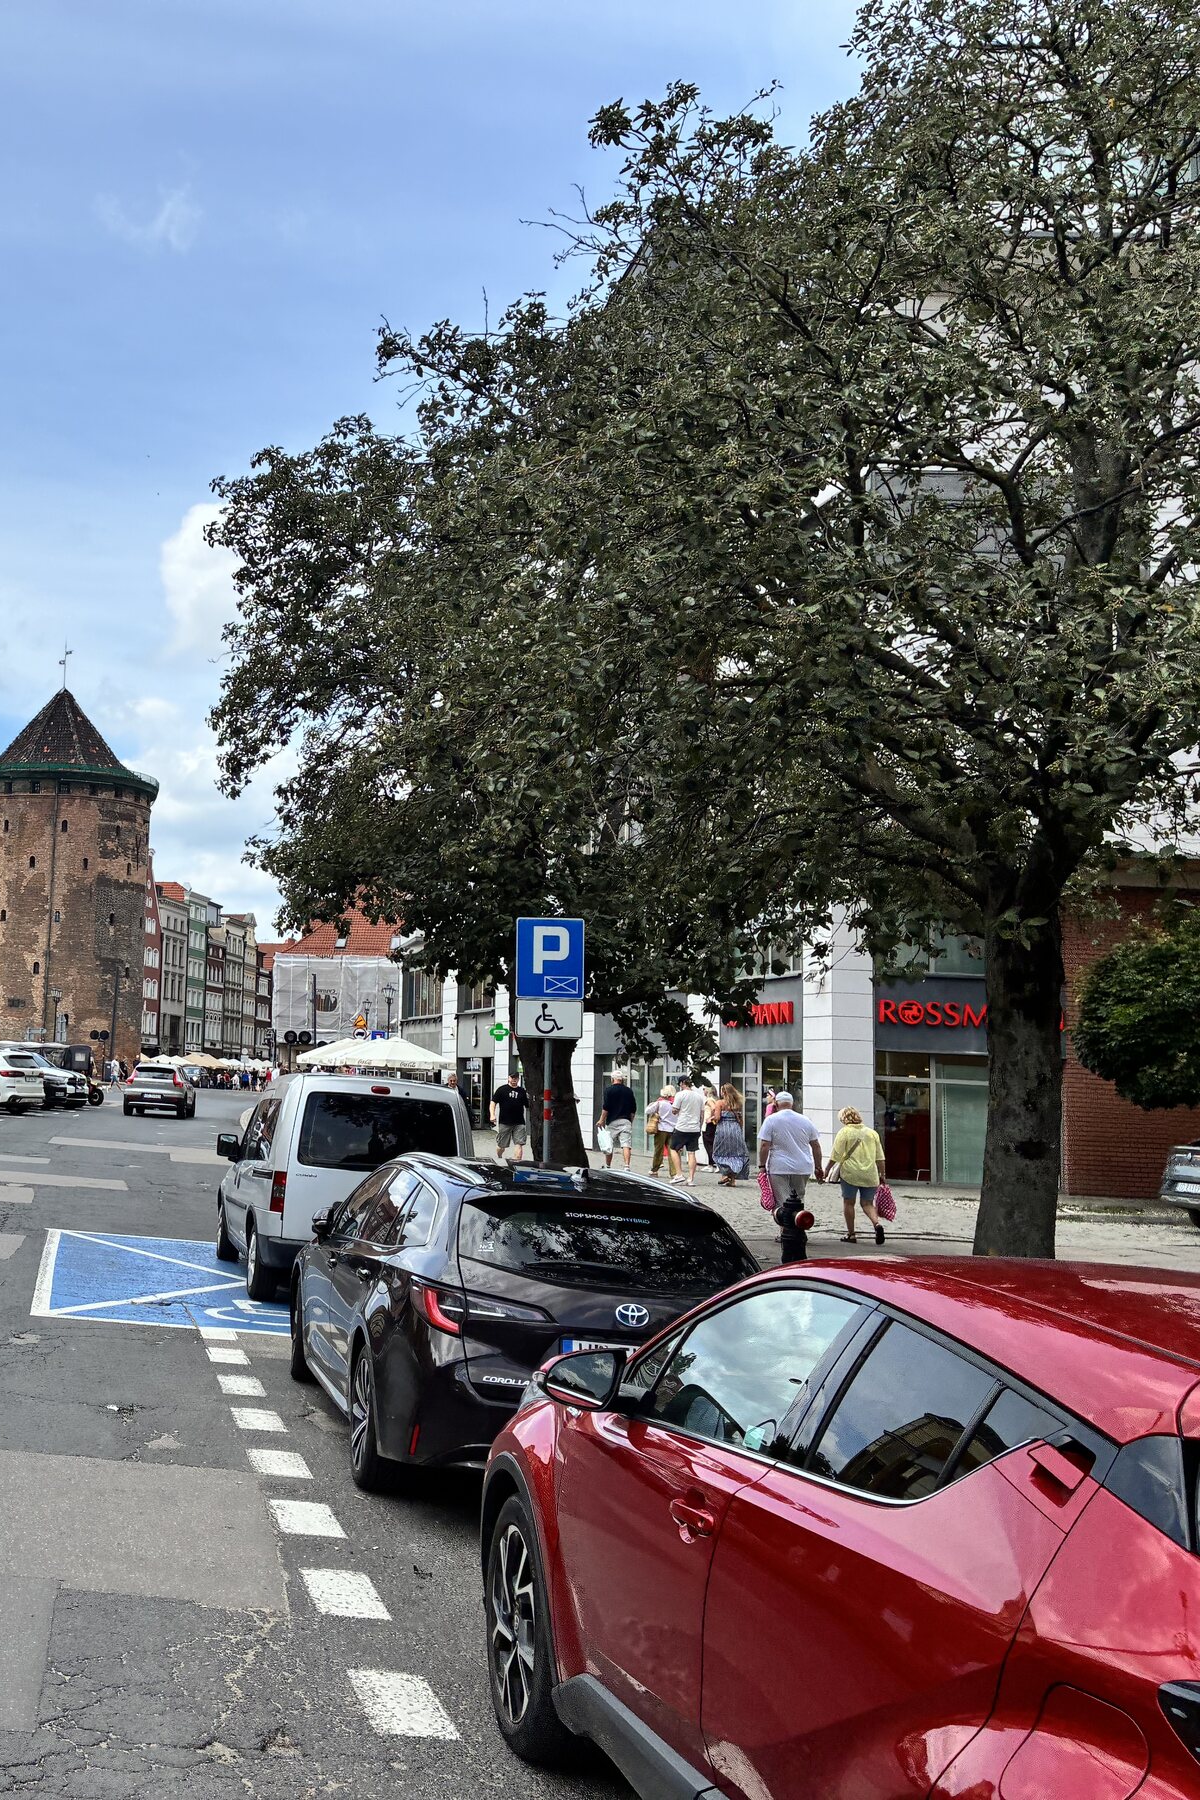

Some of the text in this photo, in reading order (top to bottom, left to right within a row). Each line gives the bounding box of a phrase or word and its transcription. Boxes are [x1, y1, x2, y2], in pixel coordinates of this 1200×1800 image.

[533, 926, 570, 974] P
[878, 998, 1066, 1031] ROSSM
[482, 1375, 530, 1385] COROLLA
